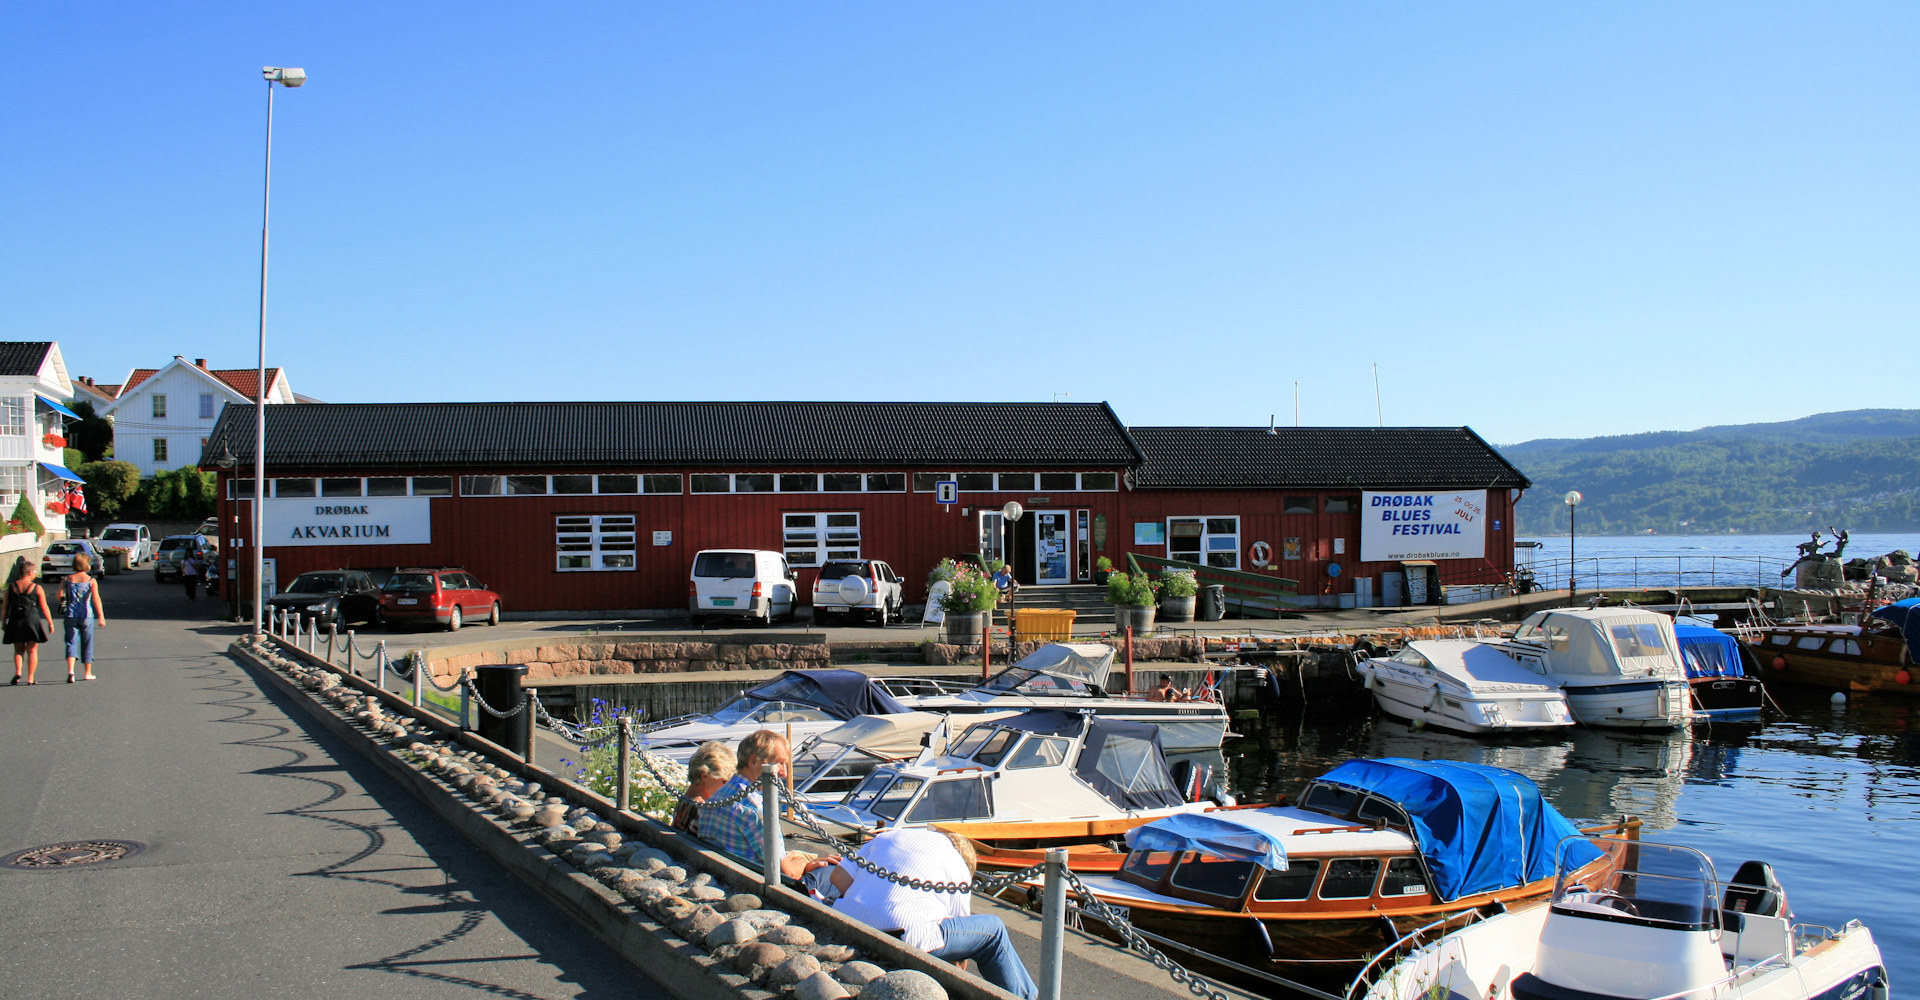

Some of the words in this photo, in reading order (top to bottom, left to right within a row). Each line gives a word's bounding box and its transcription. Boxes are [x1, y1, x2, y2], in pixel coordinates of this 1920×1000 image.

[1371, 495, 1434, 507] DRØBAK
[1463, 501, 1473, 510] OG
[315, 505, 369, 515] DRØBAK
[1382, 510, 1431, 521] BLUES
[1454, 508, 1474, 523] JULI
[291, 525, 391, 538] AKVARIUM
[1392, 523, 1461, 535] FESTIVAL
